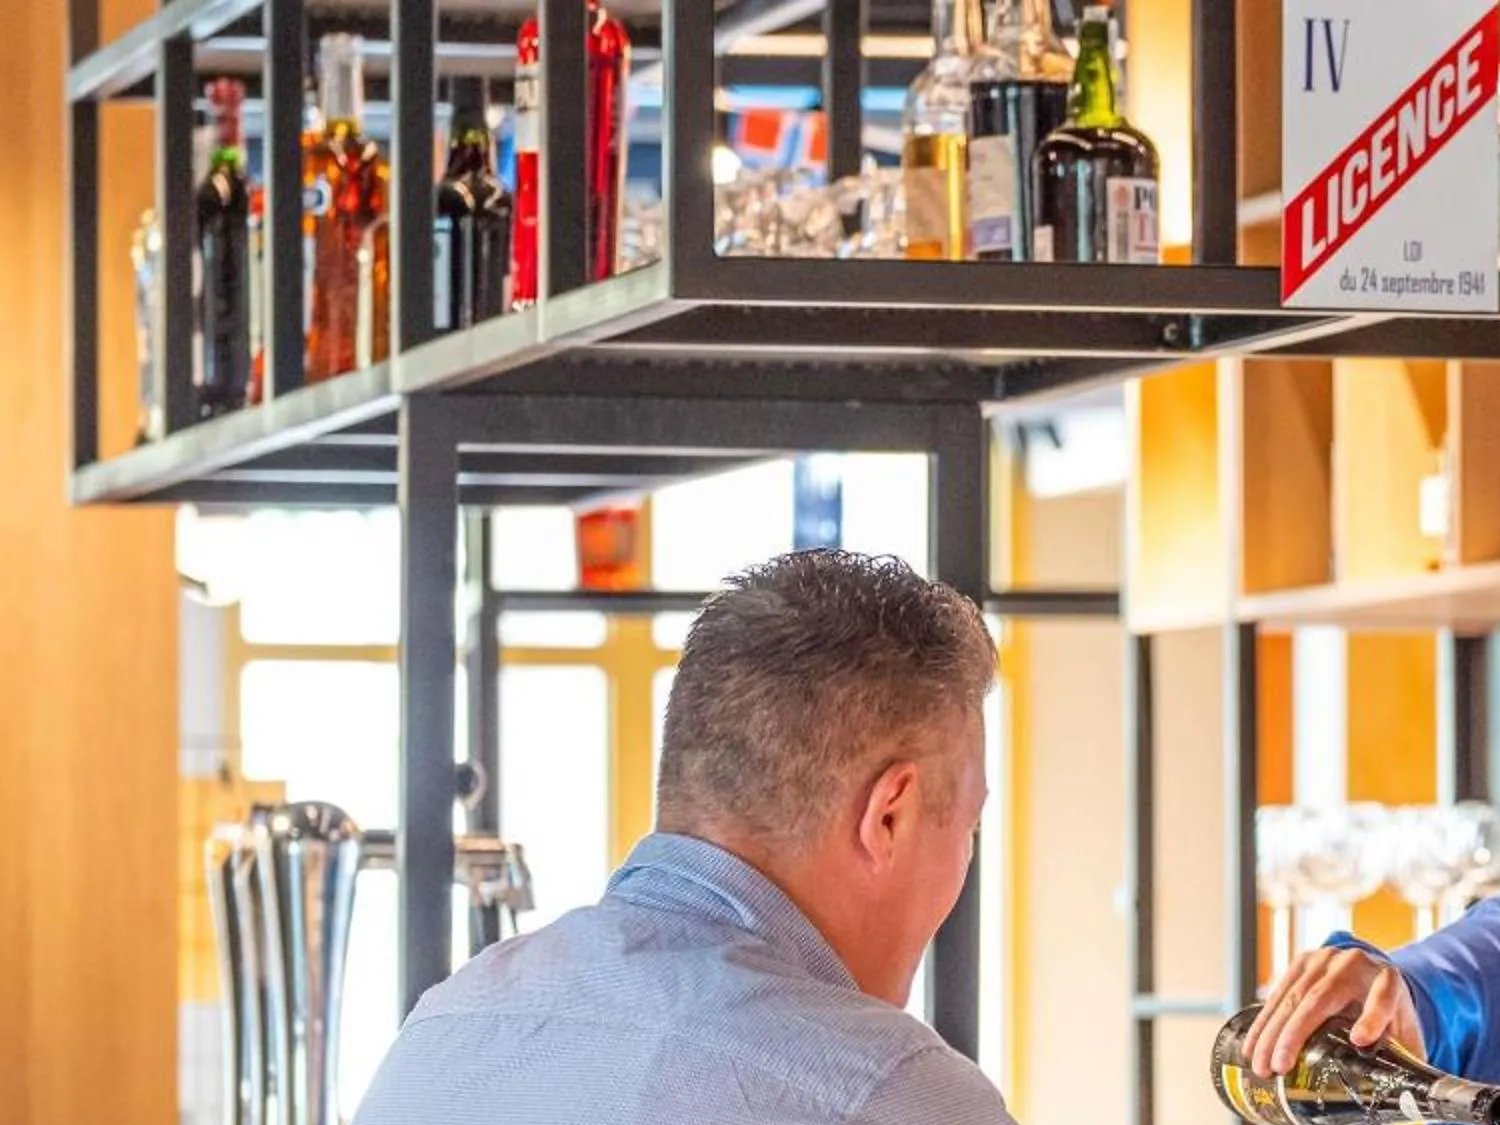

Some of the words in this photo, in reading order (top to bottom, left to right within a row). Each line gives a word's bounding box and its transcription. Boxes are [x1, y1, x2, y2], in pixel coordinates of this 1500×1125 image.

[1303, 18, 1351, 92] IV
[1301, 30, 1484, 272] LICENCE
[1402, 240, 1423, 262] LOI
[1339, 267, 1357, 291] du
[1360, 267, 1378, 292] 24
[1381, 271, 1455, 298] septembre
[1458, 271, 1486, 296] 1941
